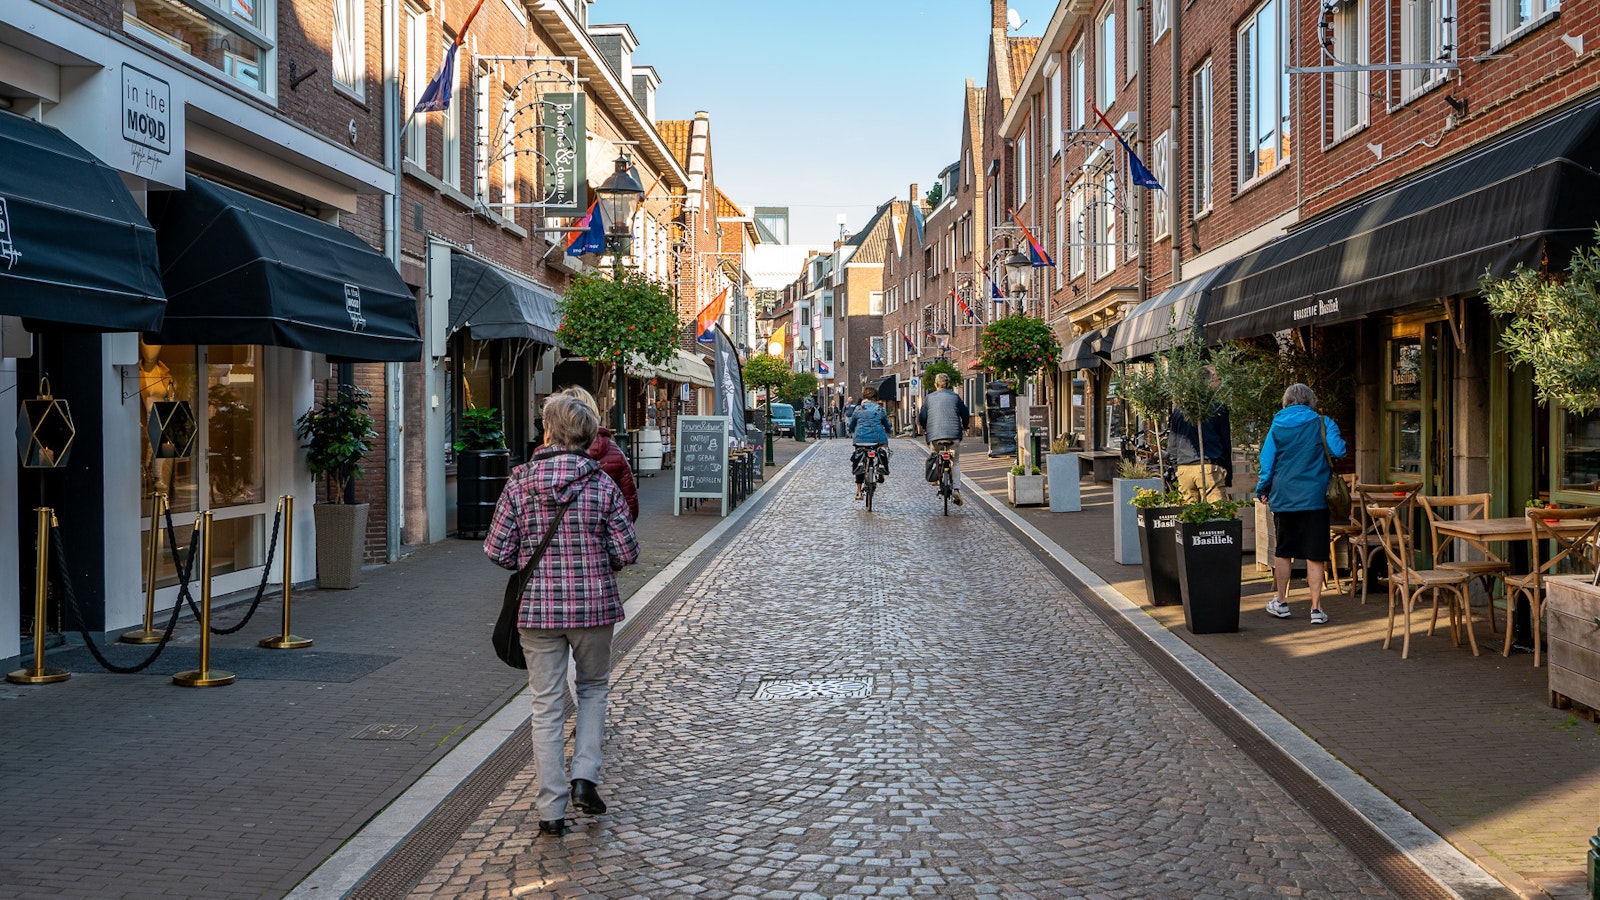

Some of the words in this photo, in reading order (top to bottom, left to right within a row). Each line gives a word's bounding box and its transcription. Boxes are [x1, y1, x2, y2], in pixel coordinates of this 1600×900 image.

[127, 79, 139, 103] in
[145, 88, 165, 114] the
[127, 108, 166, 142] MOOD
[1293, 305, 1318, 321] BRASSERIE
[683, 444, 703, 453] LUNCH
[1191, 534, 1234, 546] Basiliek
